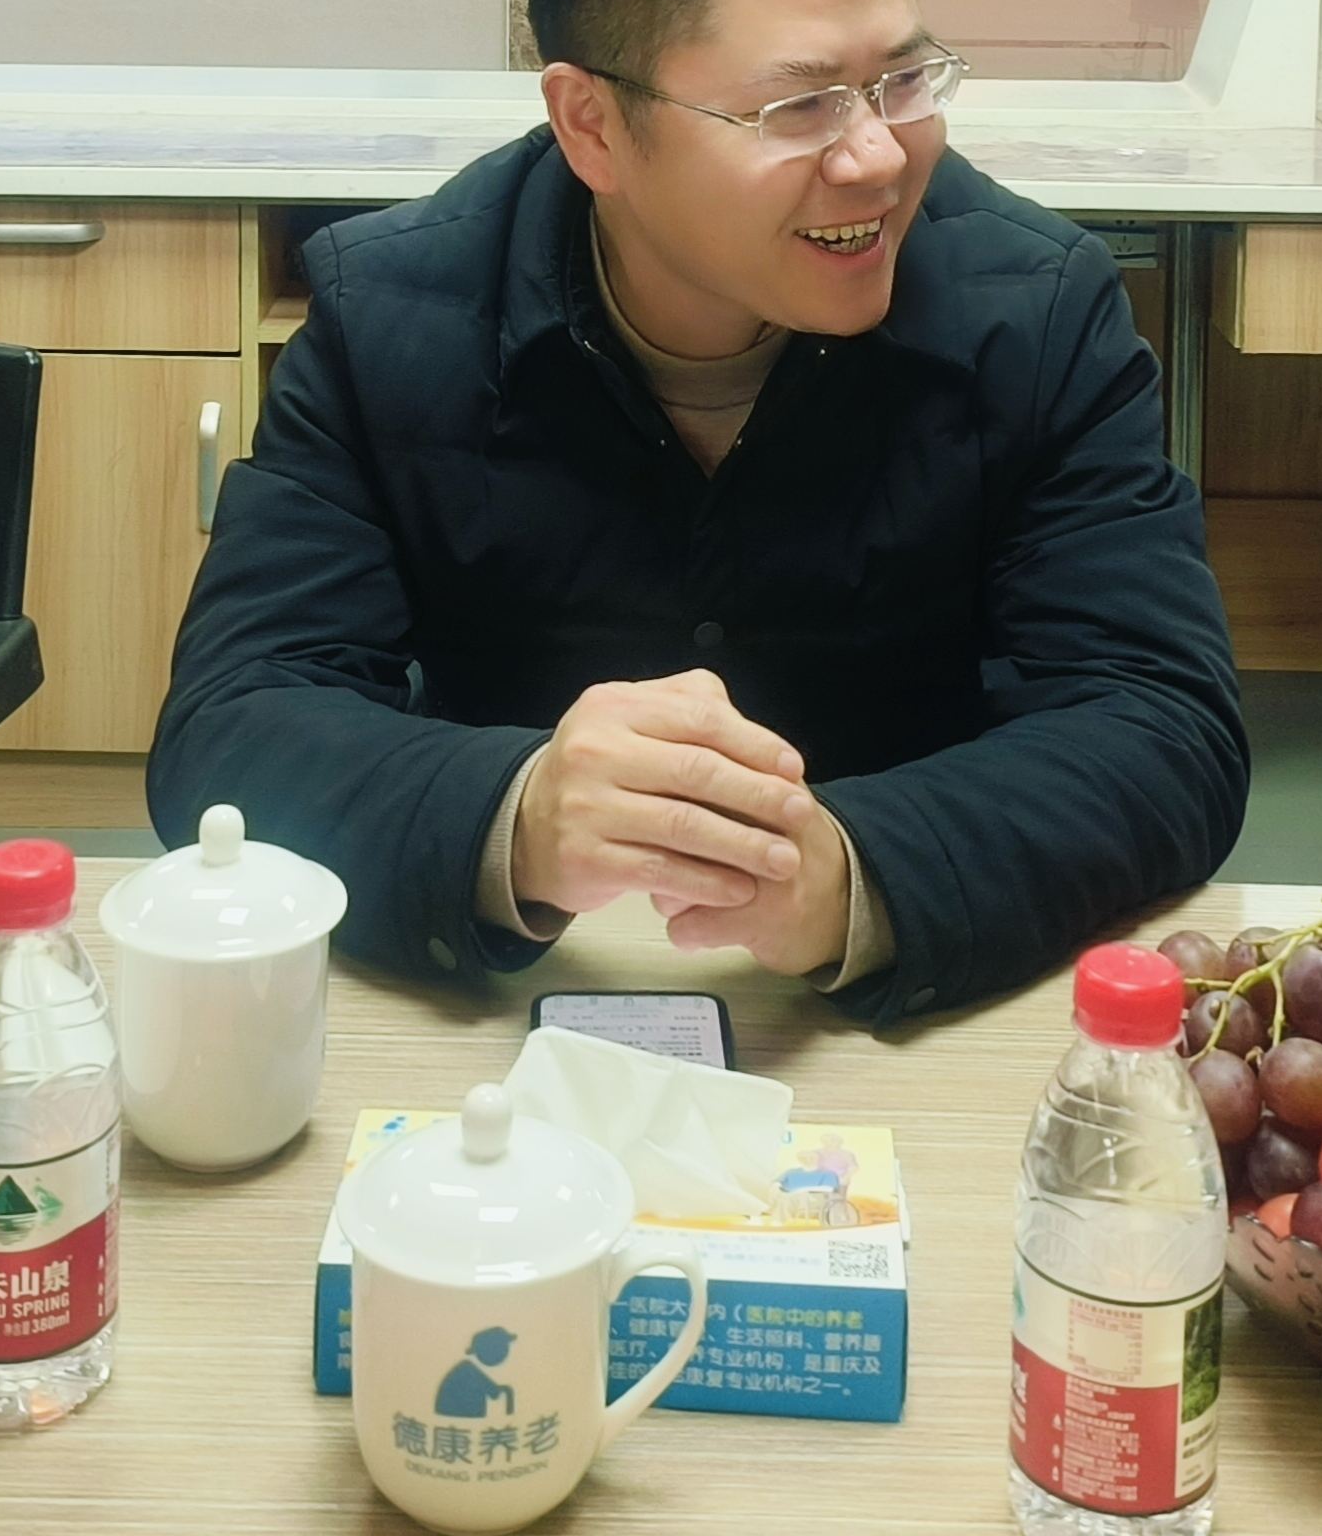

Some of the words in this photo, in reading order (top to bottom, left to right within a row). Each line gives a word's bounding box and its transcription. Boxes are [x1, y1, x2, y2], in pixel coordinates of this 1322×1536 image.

[12, 1292, 70, 1319] SPRING
[392, 1410, 561, 1465] 德康养老
[476, 1458, 550, 1483] PENSION
